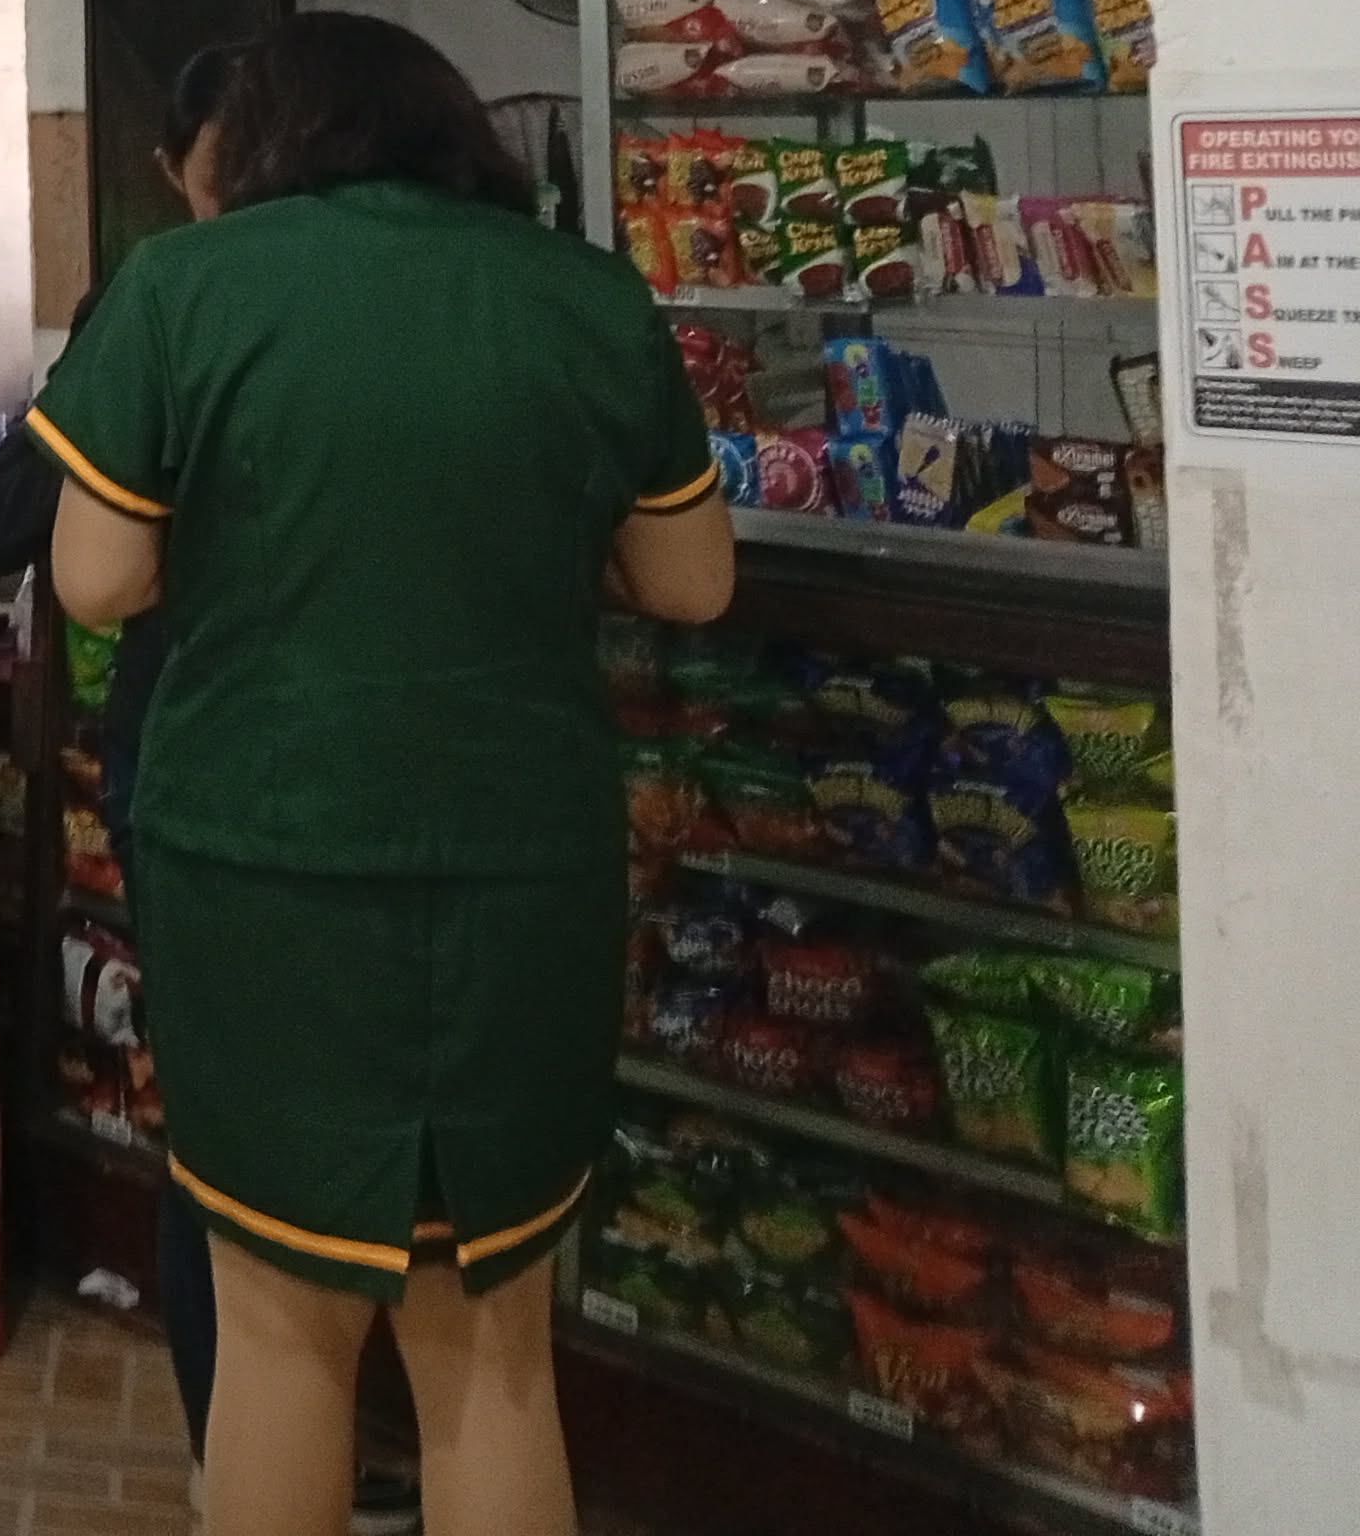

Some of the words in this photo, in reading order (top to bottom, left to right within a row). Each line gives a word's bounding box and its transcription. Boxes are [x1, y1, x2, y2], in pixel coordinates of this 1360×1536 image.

[1200, 129, 1323, 149] OPERATING
[1327, 127, 1360, 147] YO
[1188, 153, 1235, 171] FIRE
[1299, 208, 1333, 223] THE
[1342, 310, 1360, 324] TH
